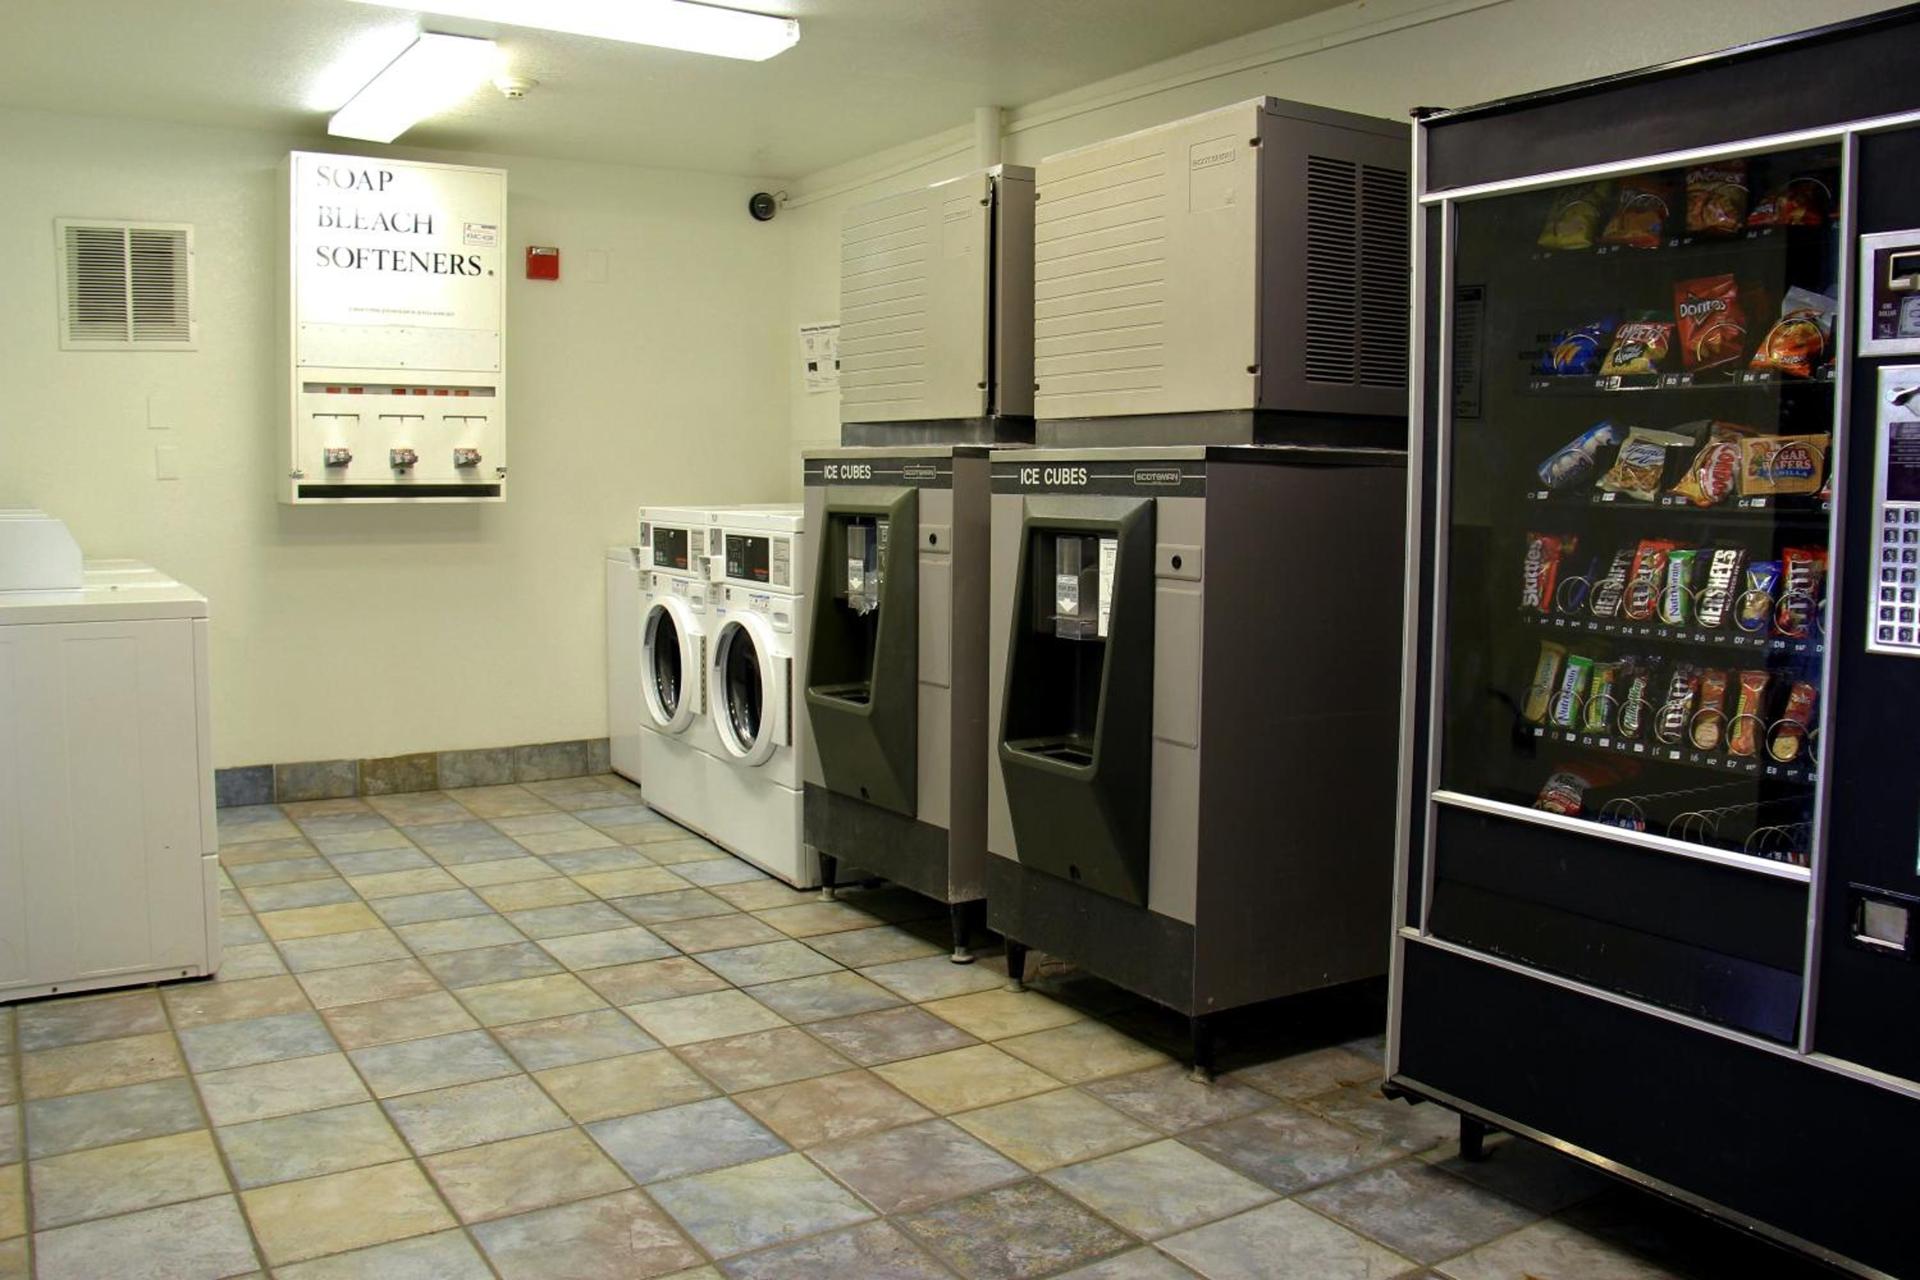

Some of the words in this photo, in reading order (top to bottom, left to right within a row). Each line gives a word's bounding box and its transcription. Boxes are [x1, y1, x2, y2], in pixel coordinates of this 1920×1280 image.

[316, 165, 393, 192] SOAP
[318, 205, 434, 236] BLEACH
[1680, 299, 1727, 318] Doritos
[1765, 449, 1808, 460] SUGAR
[823, 465, 838, 479] ICE
[840, 465, 872, 480] CUBES
[1761, 460, 1812, 472] WAFERS
[1020, 468, 1040, 485] ICE
[1044, 468, 1088, 485] CUBES
[1136, 472, 1179, 482] SCOTSMAN
[1522, 539, 1544, 608] Skittles
[1700, 549, 1738, 625] HERSHEY'S
